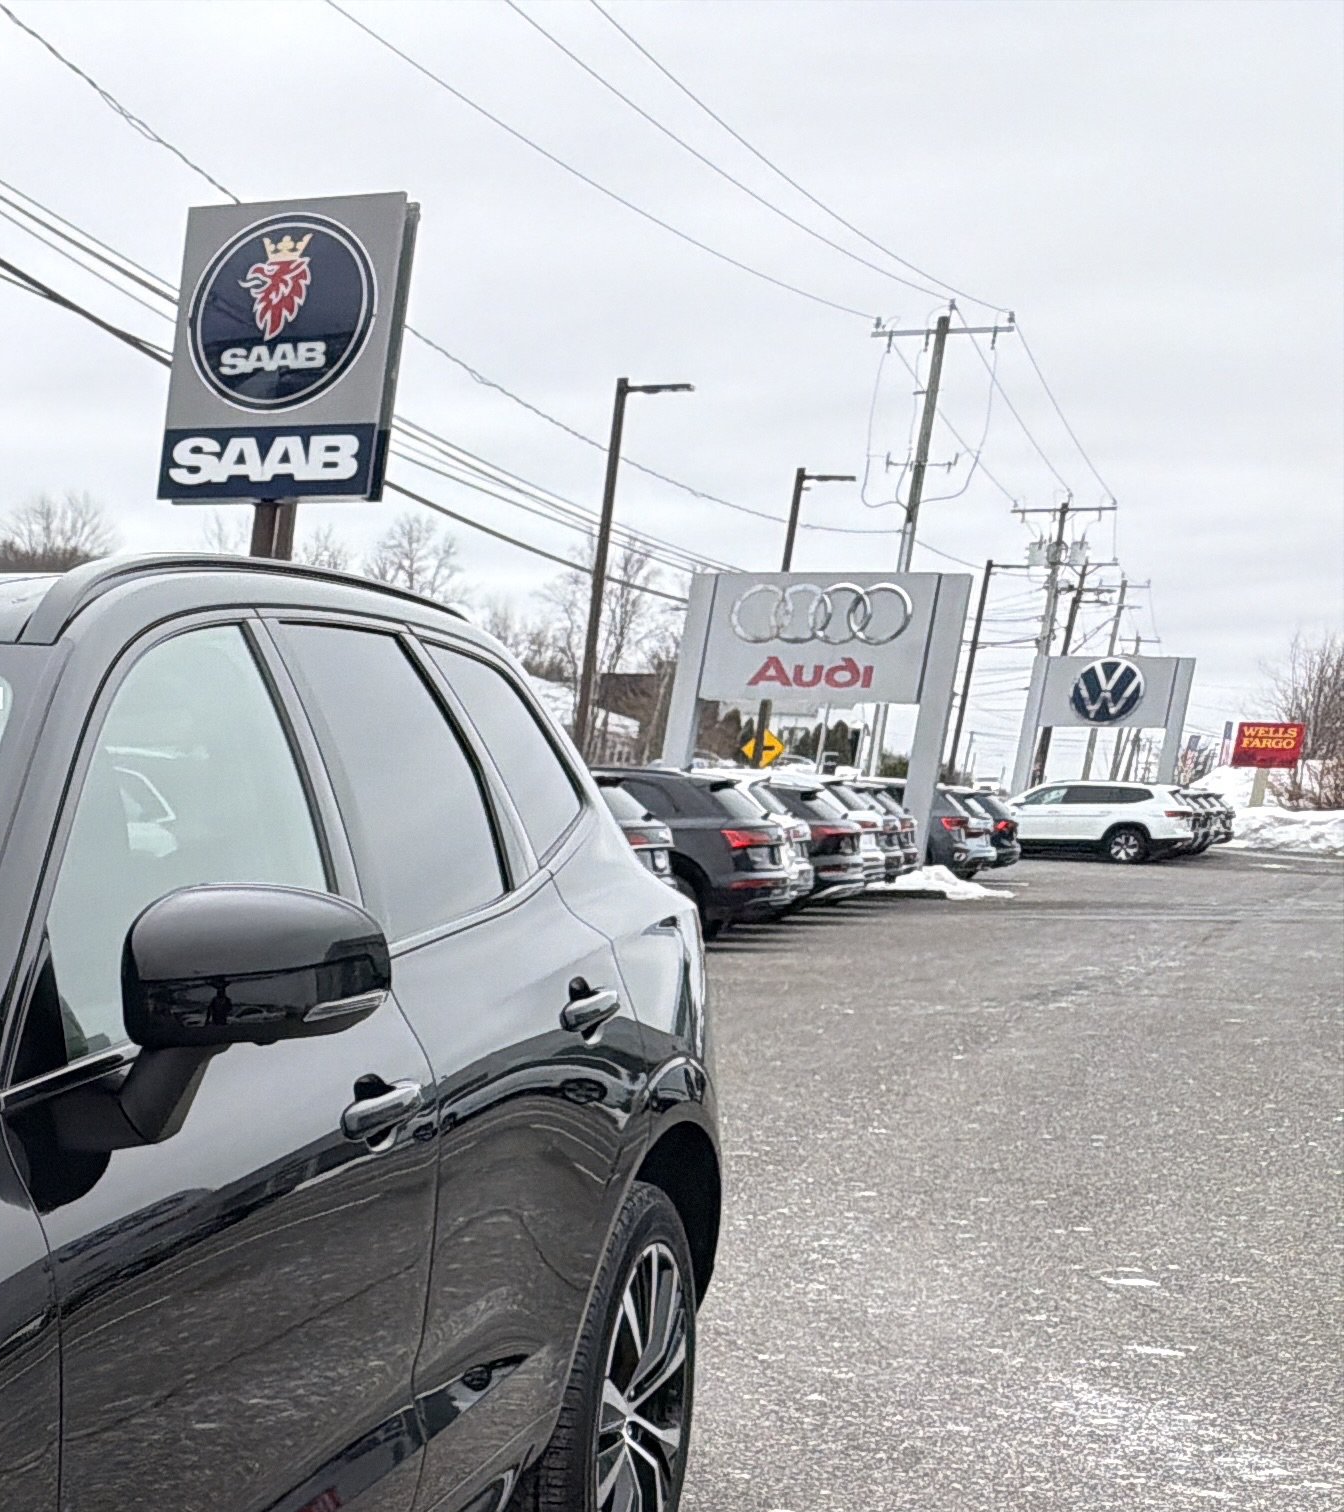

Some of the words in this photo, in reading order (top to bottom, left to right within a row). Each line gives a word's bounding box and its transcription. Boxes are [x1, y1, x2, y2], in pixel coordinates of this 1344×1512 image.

[219, 341, 328, 376] SAAB
[169, 434, 360, 486] SAAB
[746, 655, 875, 688] Audi
[1241, 737, 1296, 749] FARGO
[1243, 726, 1298, 738] WELLS
